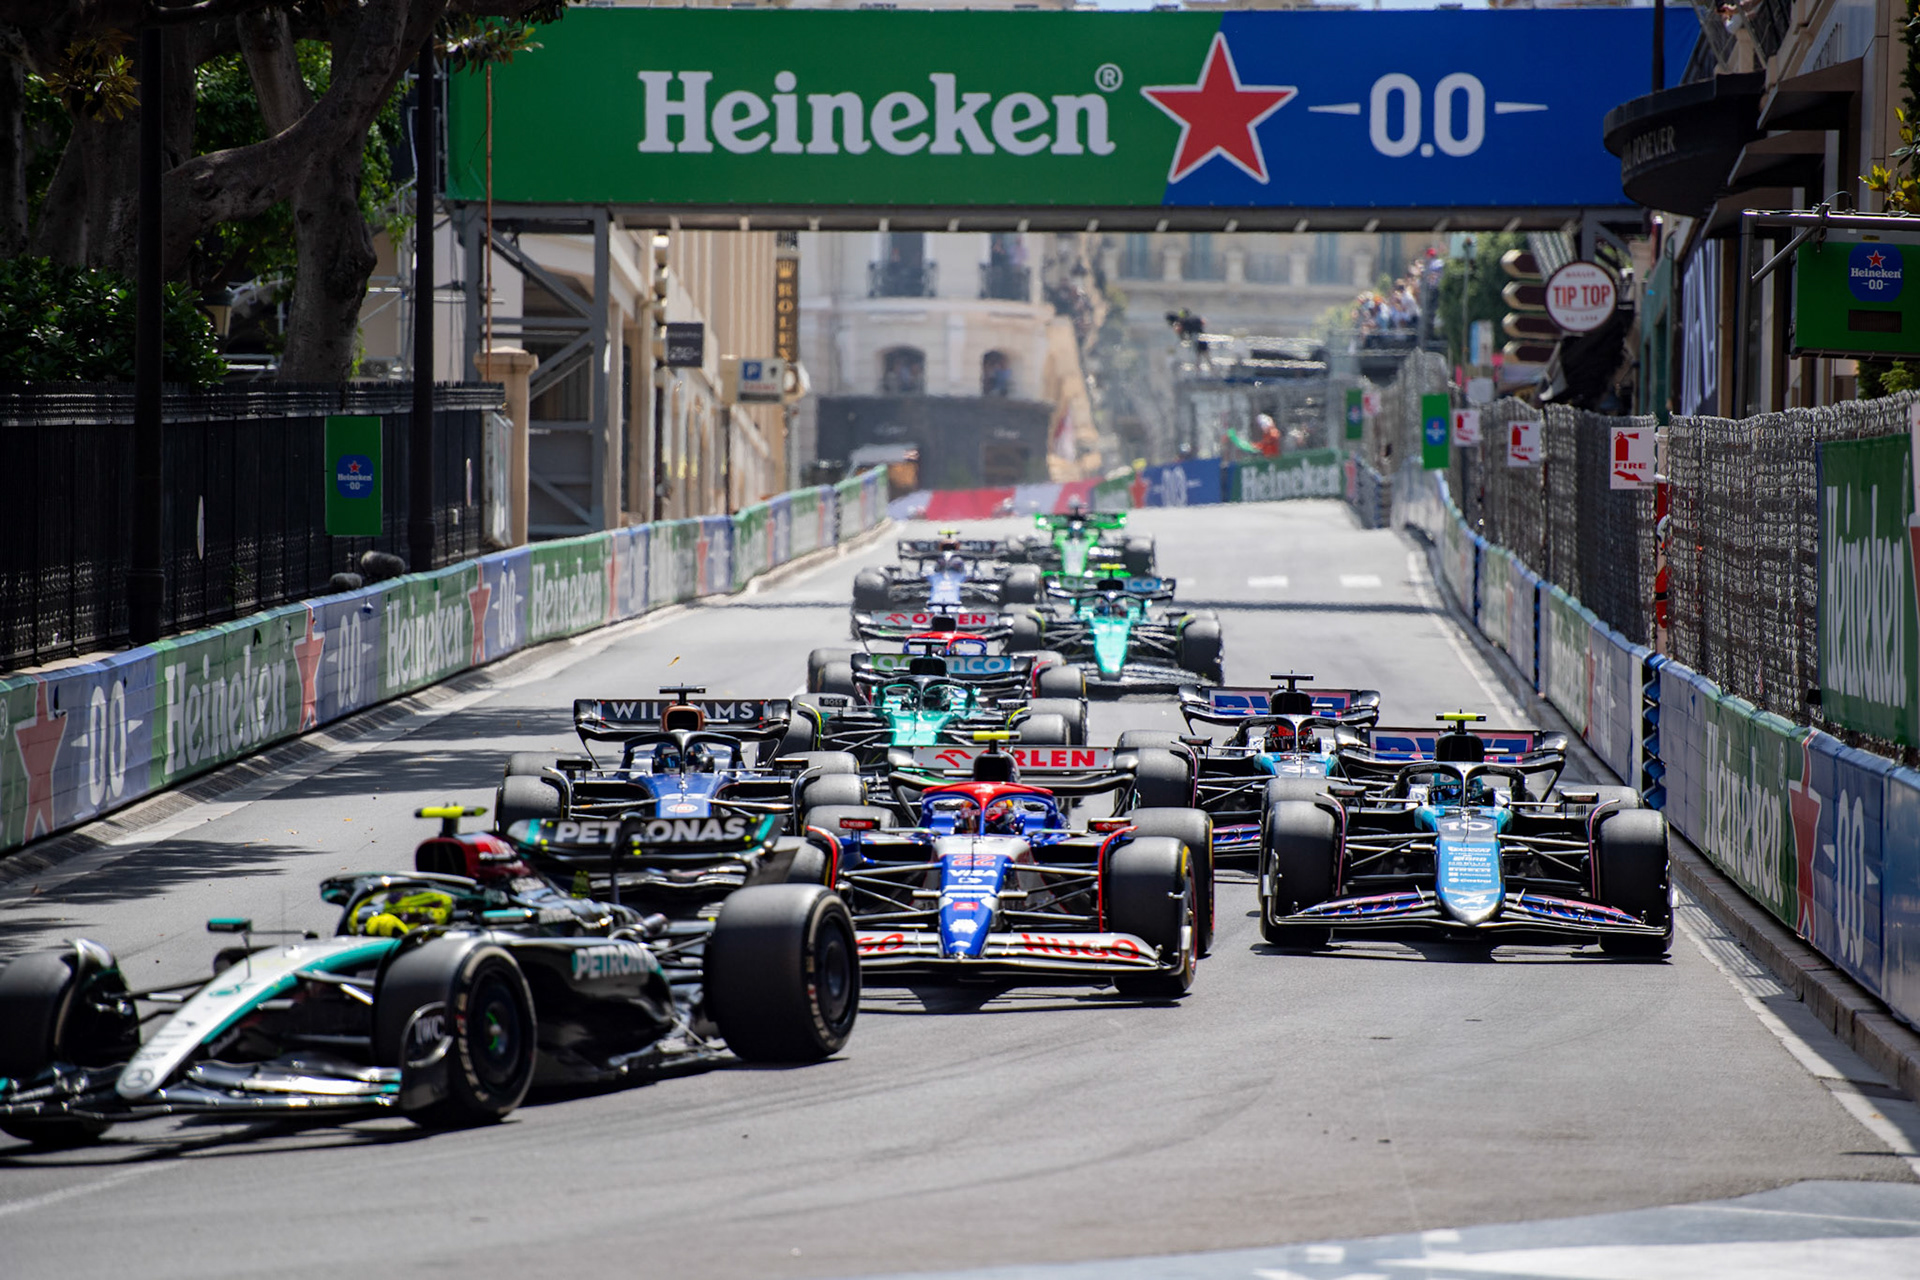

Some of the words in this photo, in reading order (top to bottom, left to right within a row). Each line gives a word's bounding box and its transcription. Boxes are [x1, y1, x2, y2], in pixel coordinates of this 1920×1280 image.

[1850, 267, 1901, 279] Heineken
[1552, 285, 1577, 307] TIP
[1581, 283, 1611, 307] TOP
[1615, 462, 1647, 470] FIRE
[531, 557, 601, 639] Heineken
[912, 613, 986, 625] OEN
[385, 590, 465, 688] Heineken
[164, 644, 287, 775] Heineken
[611, 701, 755, 719] WILAMS
[1010, 750, 1095, 767] RLEN
[1704, 721, 1783, 907] Heineken
[1441, 821, 1493, 831] 10
[951, 855, 997, 866] 22
[948, 869, 998, 877] VISA
[1022, 932, 1140, 960] HUGO
